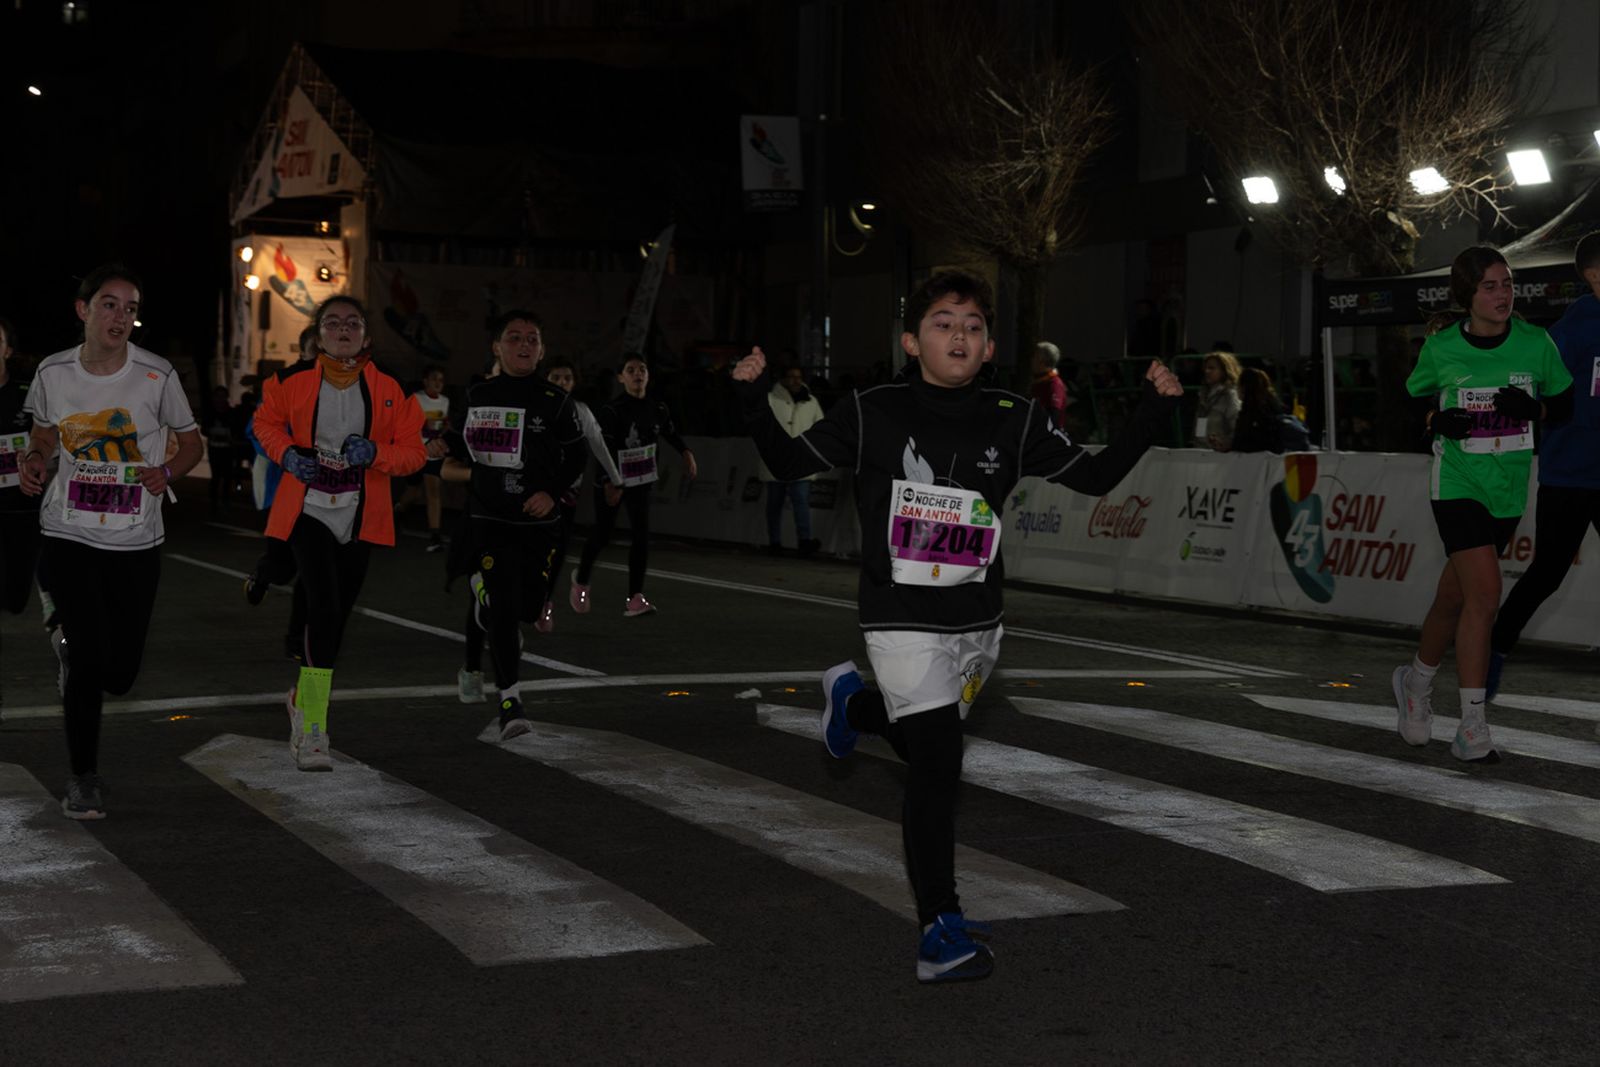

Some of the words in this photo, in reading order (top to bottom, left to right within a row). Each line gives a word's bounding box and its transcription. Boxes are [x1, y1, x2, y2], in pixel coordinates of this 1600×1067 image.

[1467, 403, 1482, 411] SAN
[1475, 394, 1494, 402] NOCH
[75, 474, 91, 482] SAN
[901, 504, 922, 518] SAN
[914, 495, 947, 510] NOCHE
[949, 499, 963, 511] DE
[1178, 486, 1242, 523] XAVE
[1326, 493, 1385, 534] SAN
[900, 519, 985, 557] 15204
[1015, 506, 1062, 538] aqualia
[1284, 508, 1321, 569] 43
[1318, 529, 1416, 582] ANTÓN
